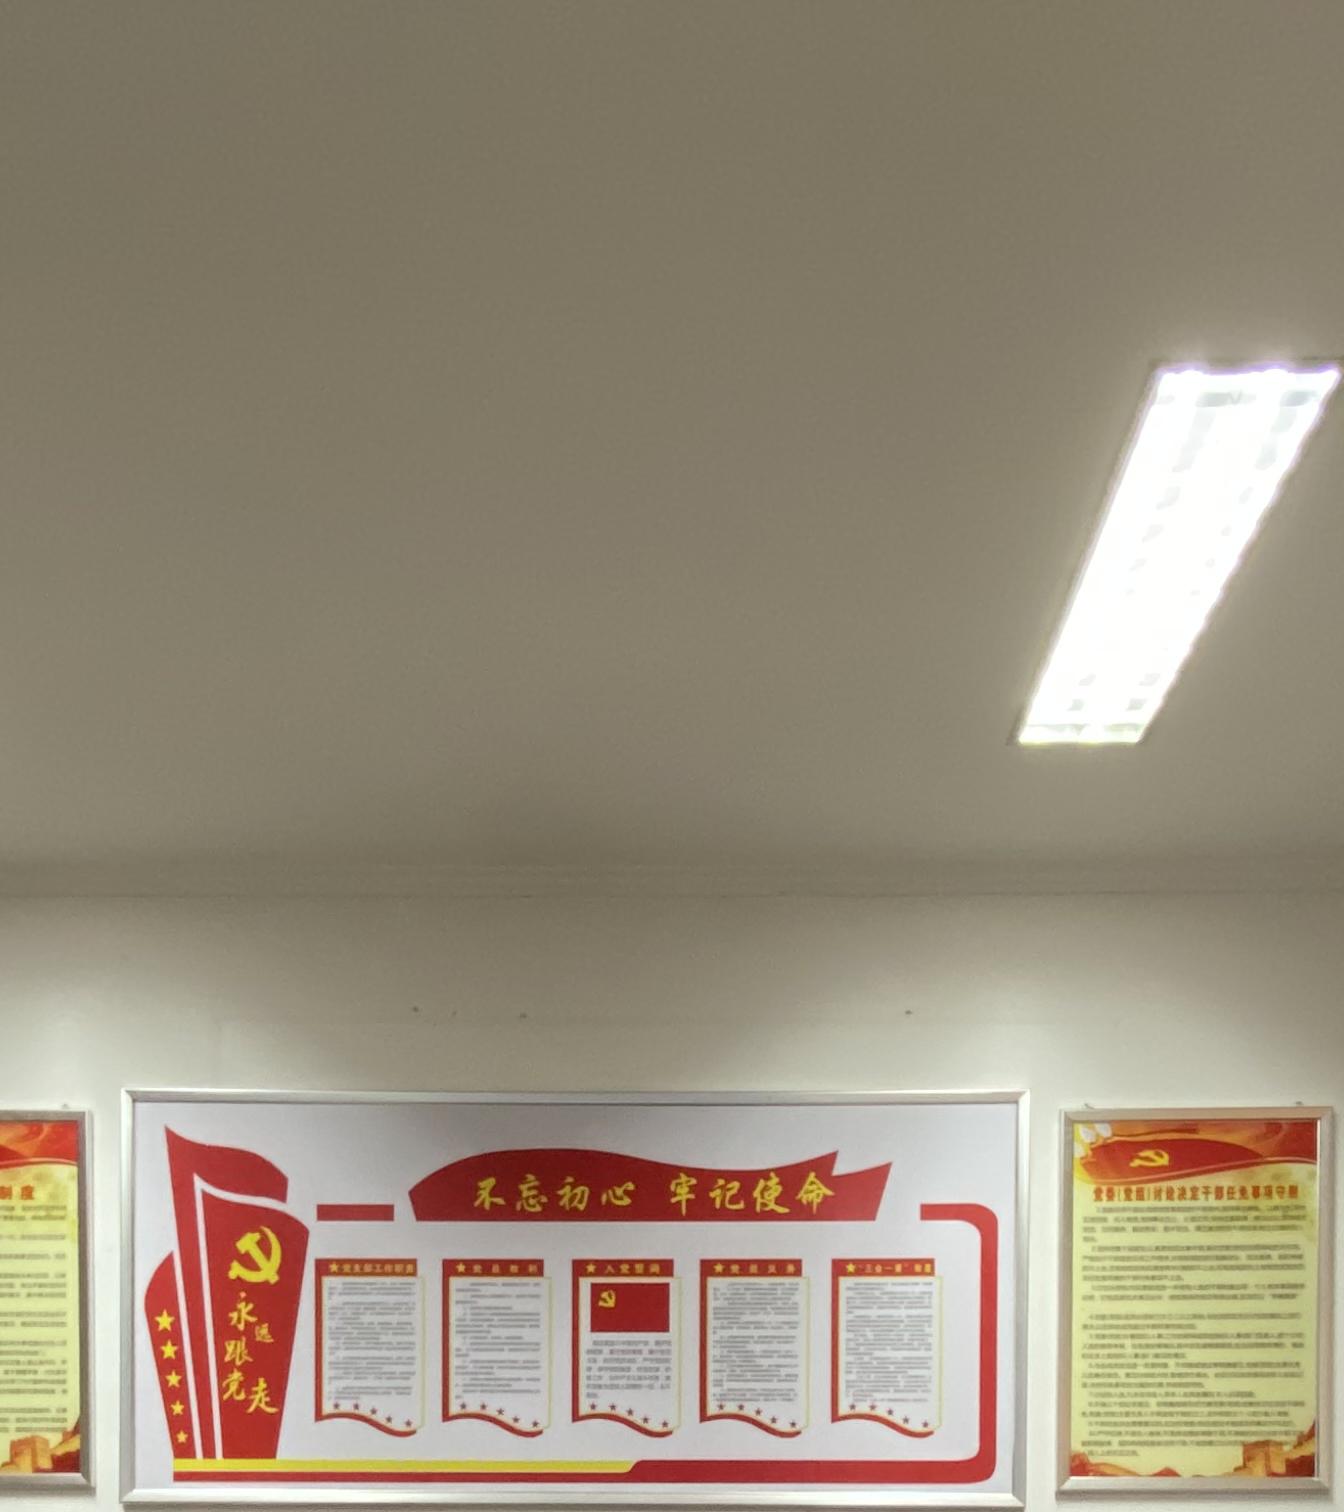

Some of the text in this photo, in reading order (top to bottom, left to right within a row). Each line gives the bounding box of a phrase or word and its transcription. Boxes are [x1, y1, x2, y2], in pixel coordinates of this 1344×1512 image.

[473, 1171, 836, 1217] 不忘初心 牢记使命
[222, 1291, 280, 1414] 永远跟党走
